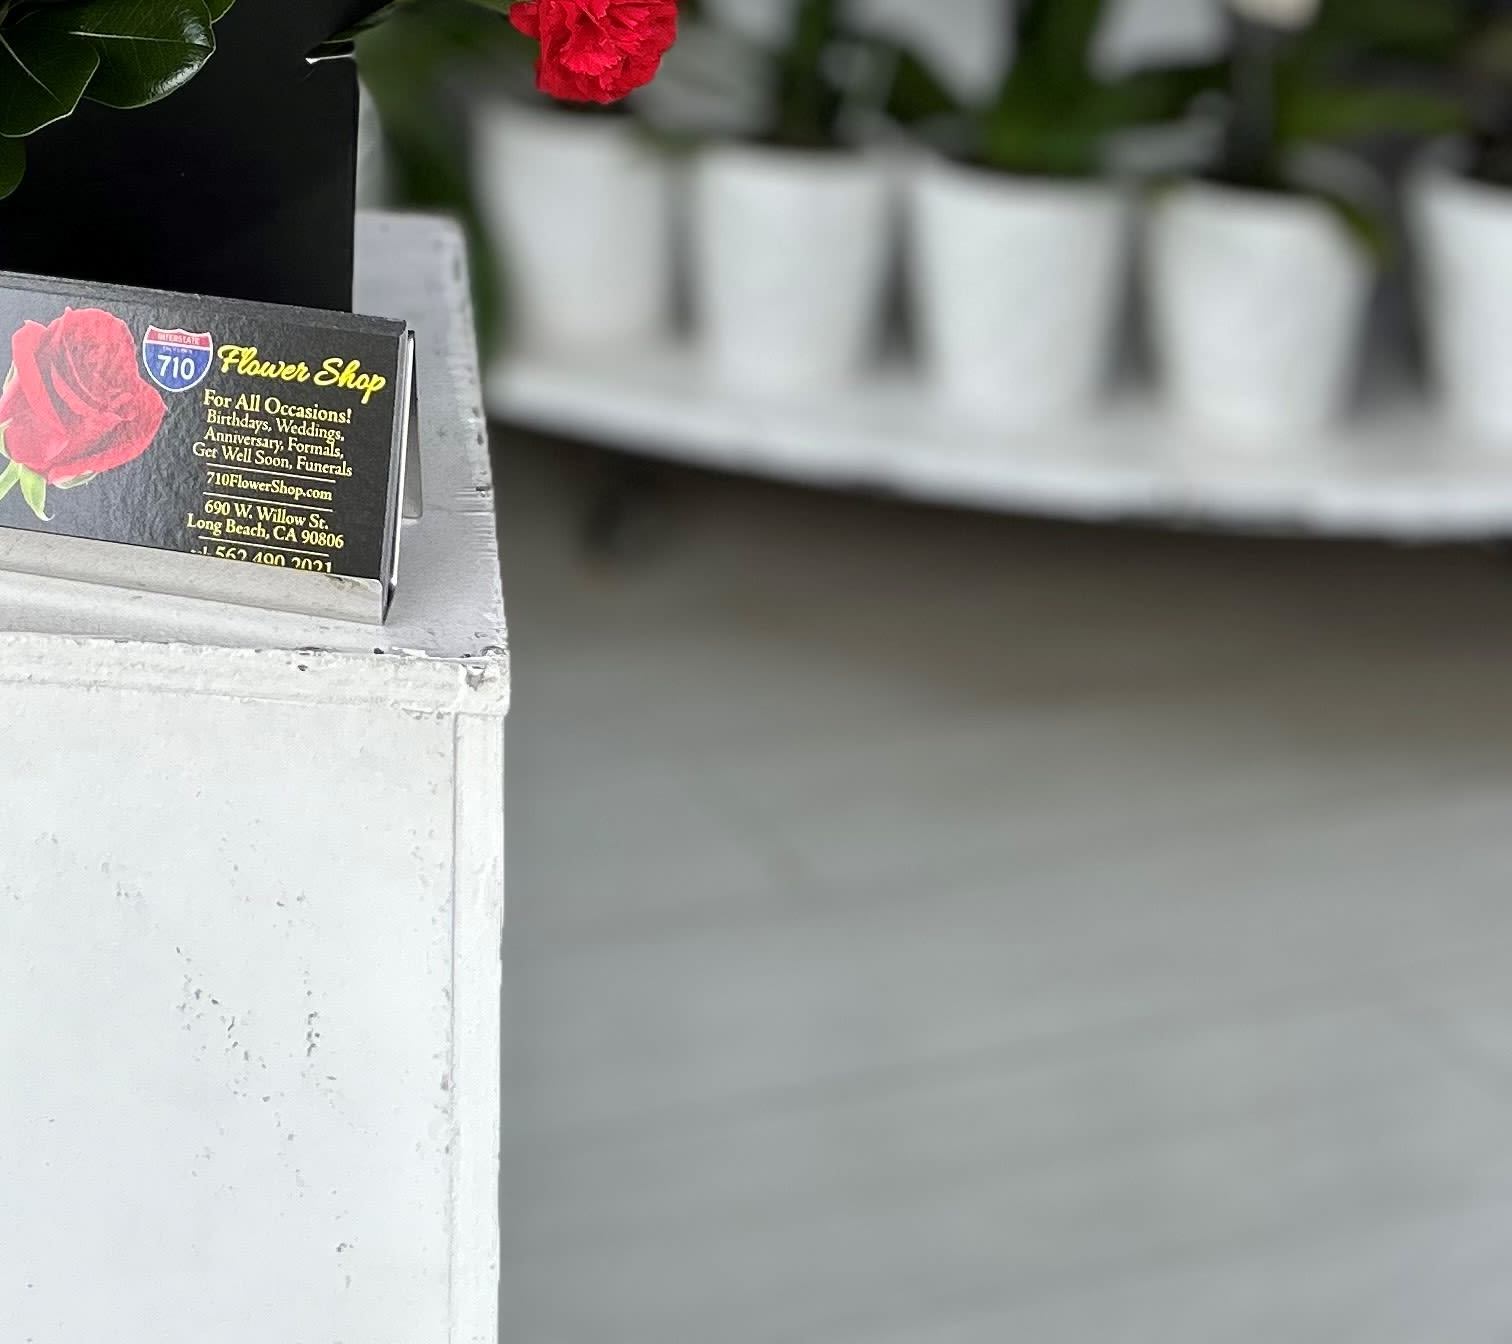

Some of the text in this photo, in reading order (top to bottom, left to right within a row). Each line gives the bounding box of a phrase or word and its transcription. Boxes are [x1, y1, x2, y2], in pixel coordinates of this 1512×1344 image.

[157, 354, 195, 381] 710
[217, 344, 386, 404] Flower Shop
[203, 388, 352, 424] For All Occasions!
[206, 408, 272, 434] Birthdays,
[192, 441, 353, 477] Get Well Soon, Funerals
[203, 426, 344, 460] Anniversary, Formals,
[206, 471, 333, 500] 710FlowerShop.com
[186, 512, 344, 549] Long Beach, CA 90806
[204, 499, 329, 530] 690 W. Willow St.
